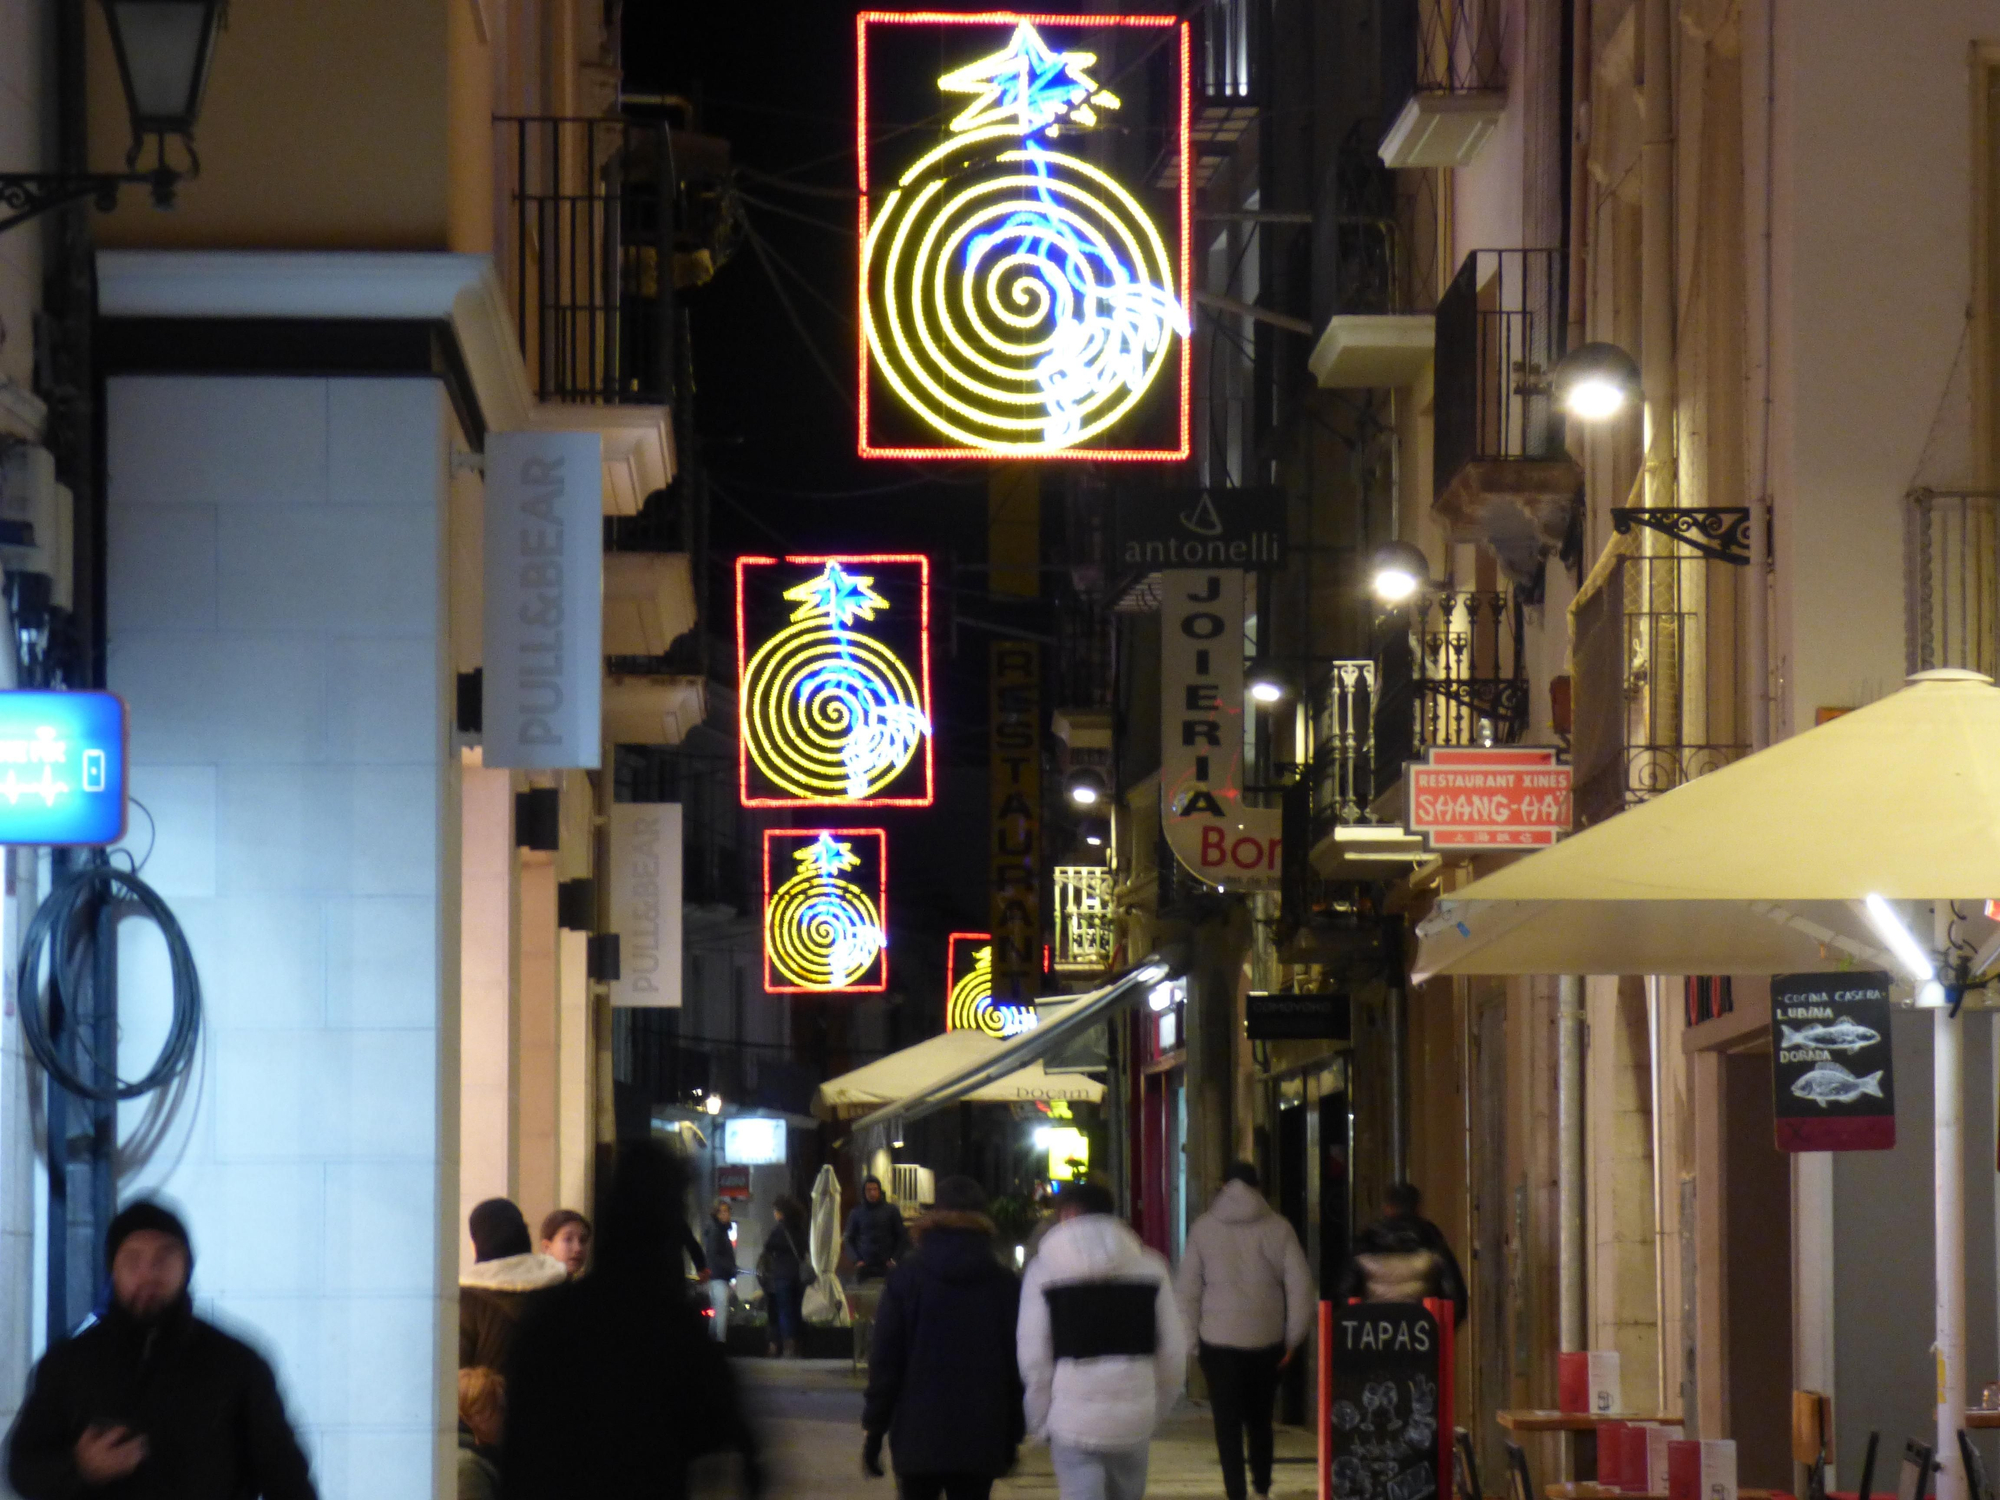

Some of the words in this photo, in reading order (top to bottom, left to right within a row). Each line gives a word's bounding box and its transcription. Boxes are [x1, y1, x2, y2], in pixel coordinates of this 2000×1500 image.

[1124, 532, 1279, 563] antonelli
[518, 453, 566, 748] PULL&BEAR
[1178, 576, 1226, 817] JOIERIA
[1418, 774, 1515, 788] RESTAURANT
[996, 650, 1035, 999] RESTAURANT
[631, 815, 660, 994] PULL&BEAR
[1784, 991, 1829, 1003] COCINA
[1834, 989, 1881, 1002] CASERA
[1776, 1006, 1834, 1019] LUBINA
[1780, 1049, 1832, 1063] DORADA
[1341, 1320, 1430, 1352] TAPAS
